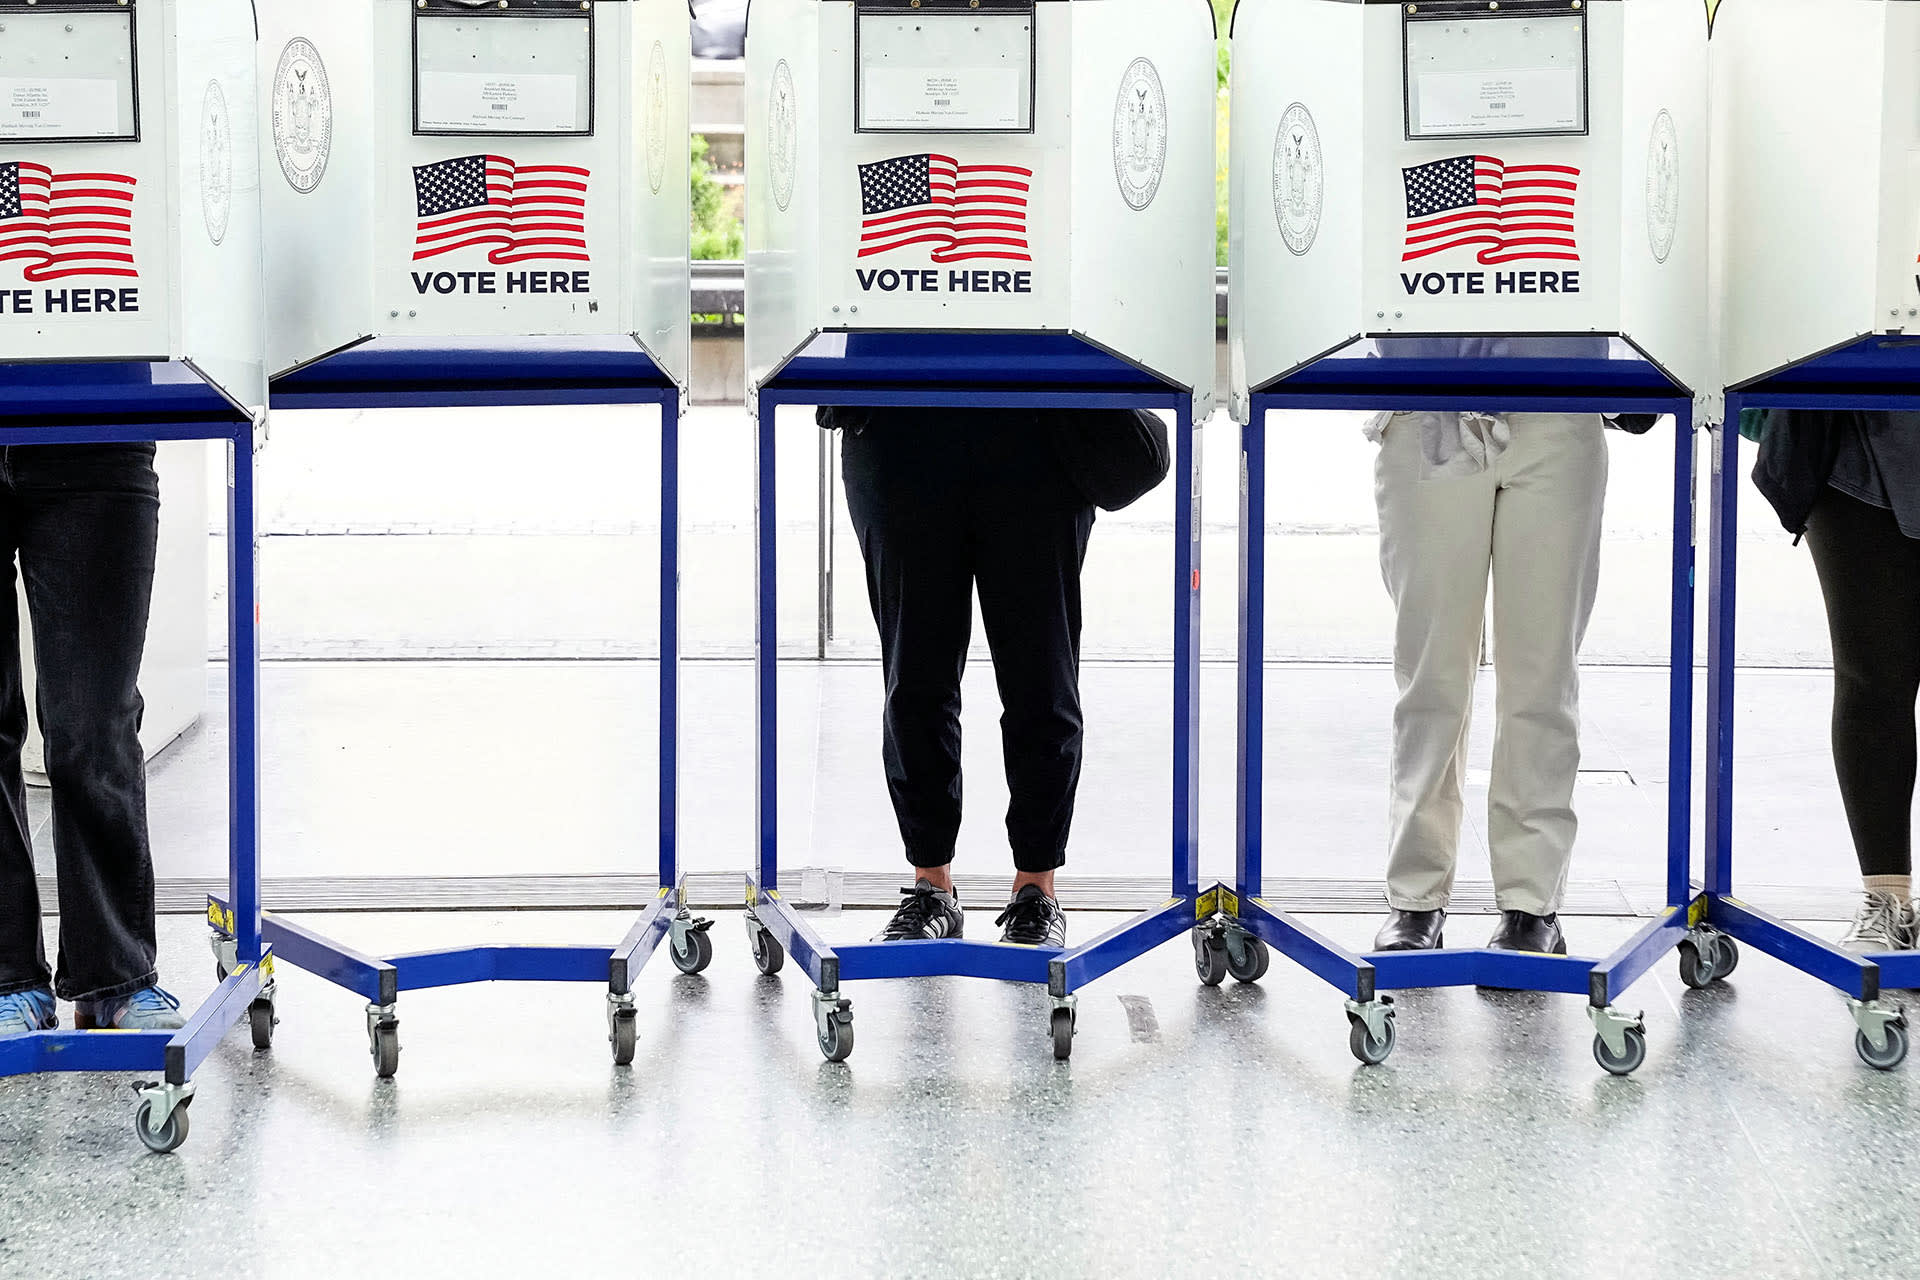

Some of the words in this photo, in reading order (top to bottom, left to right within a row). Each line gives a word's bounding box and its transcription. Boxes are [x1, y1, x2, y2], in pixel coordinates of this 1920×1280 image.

[410, 270, 496, 295] VOTE
[506, 270, 590, 294] HERE
[855, 268, 939, 292] VOTE
[948, 269, 1032, 293] HERE
[1399, 271, 1485, 295] VOTE
[1495, 270, 1580, 294] HERE
[45, 287, 139, 314] HERE
